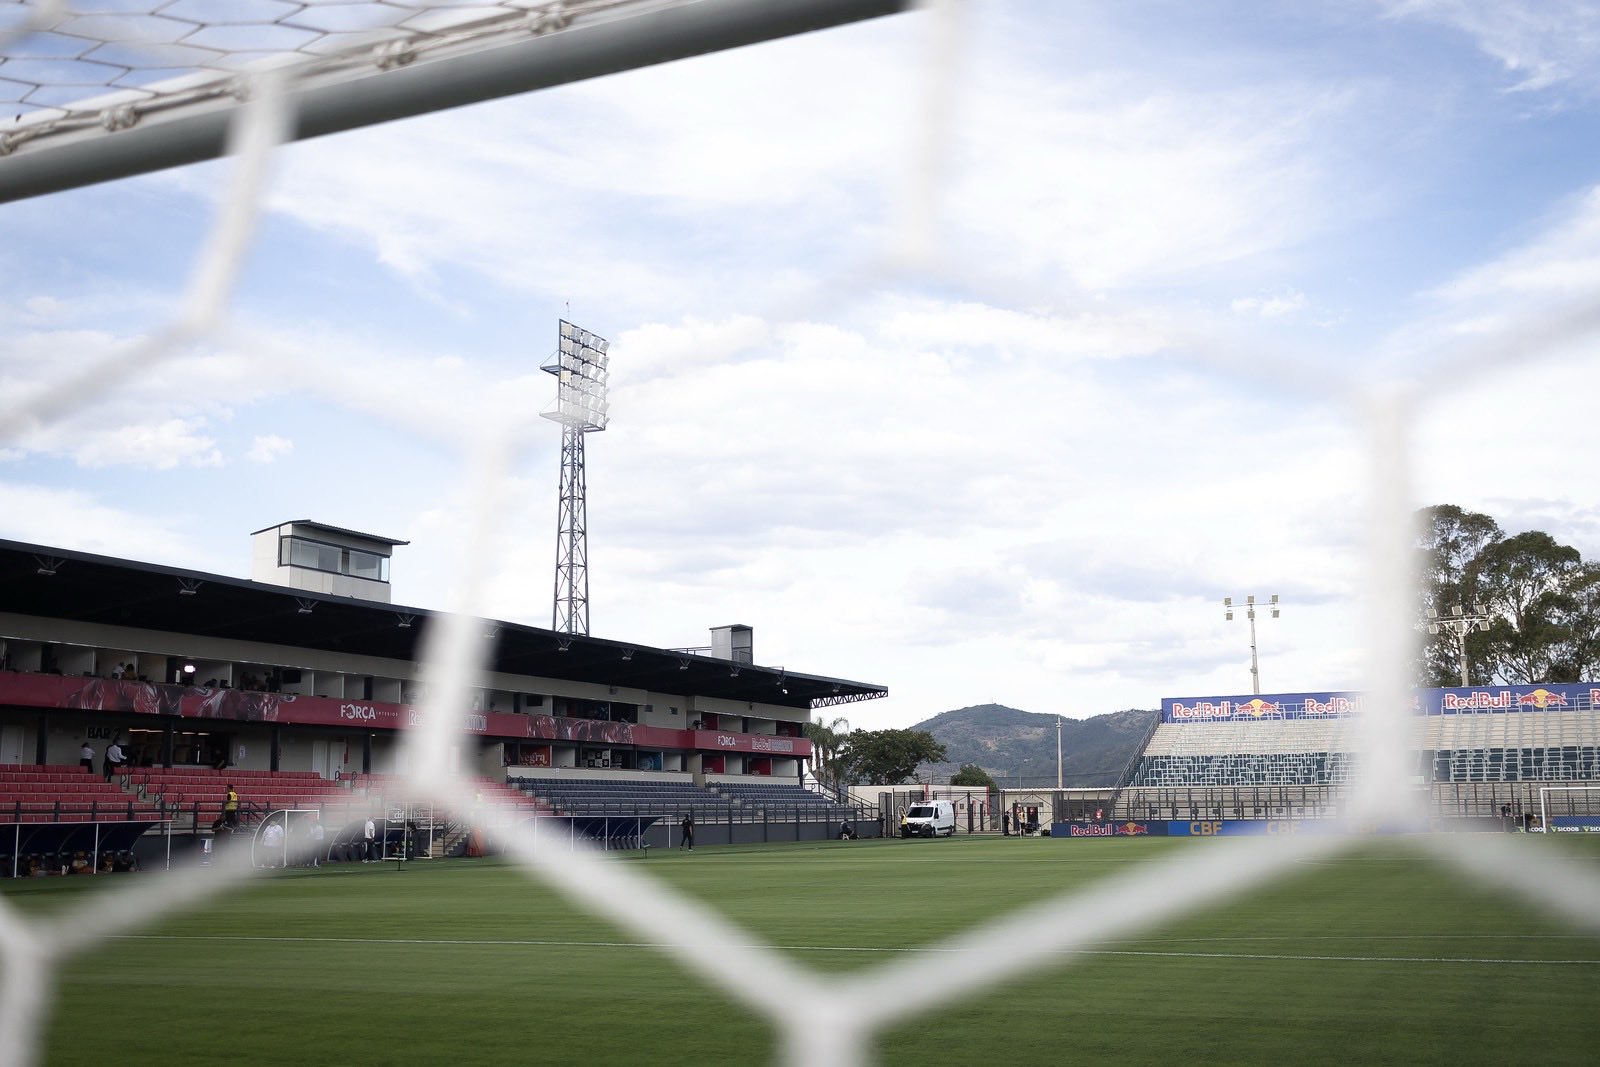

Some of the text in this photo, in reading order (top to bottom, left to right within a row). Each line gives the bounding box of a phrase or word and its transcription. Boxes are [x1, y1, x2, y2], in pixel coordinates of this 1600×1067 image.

[1305, 697, 1336, 713] Red
[1445, 691, 1511, 709] Red Bull
[1173, 701, 1230, 717] Red Bull
[1071, 824, 1112, 836] Red Bull
[1190, 821, 1222, 835] CBF
